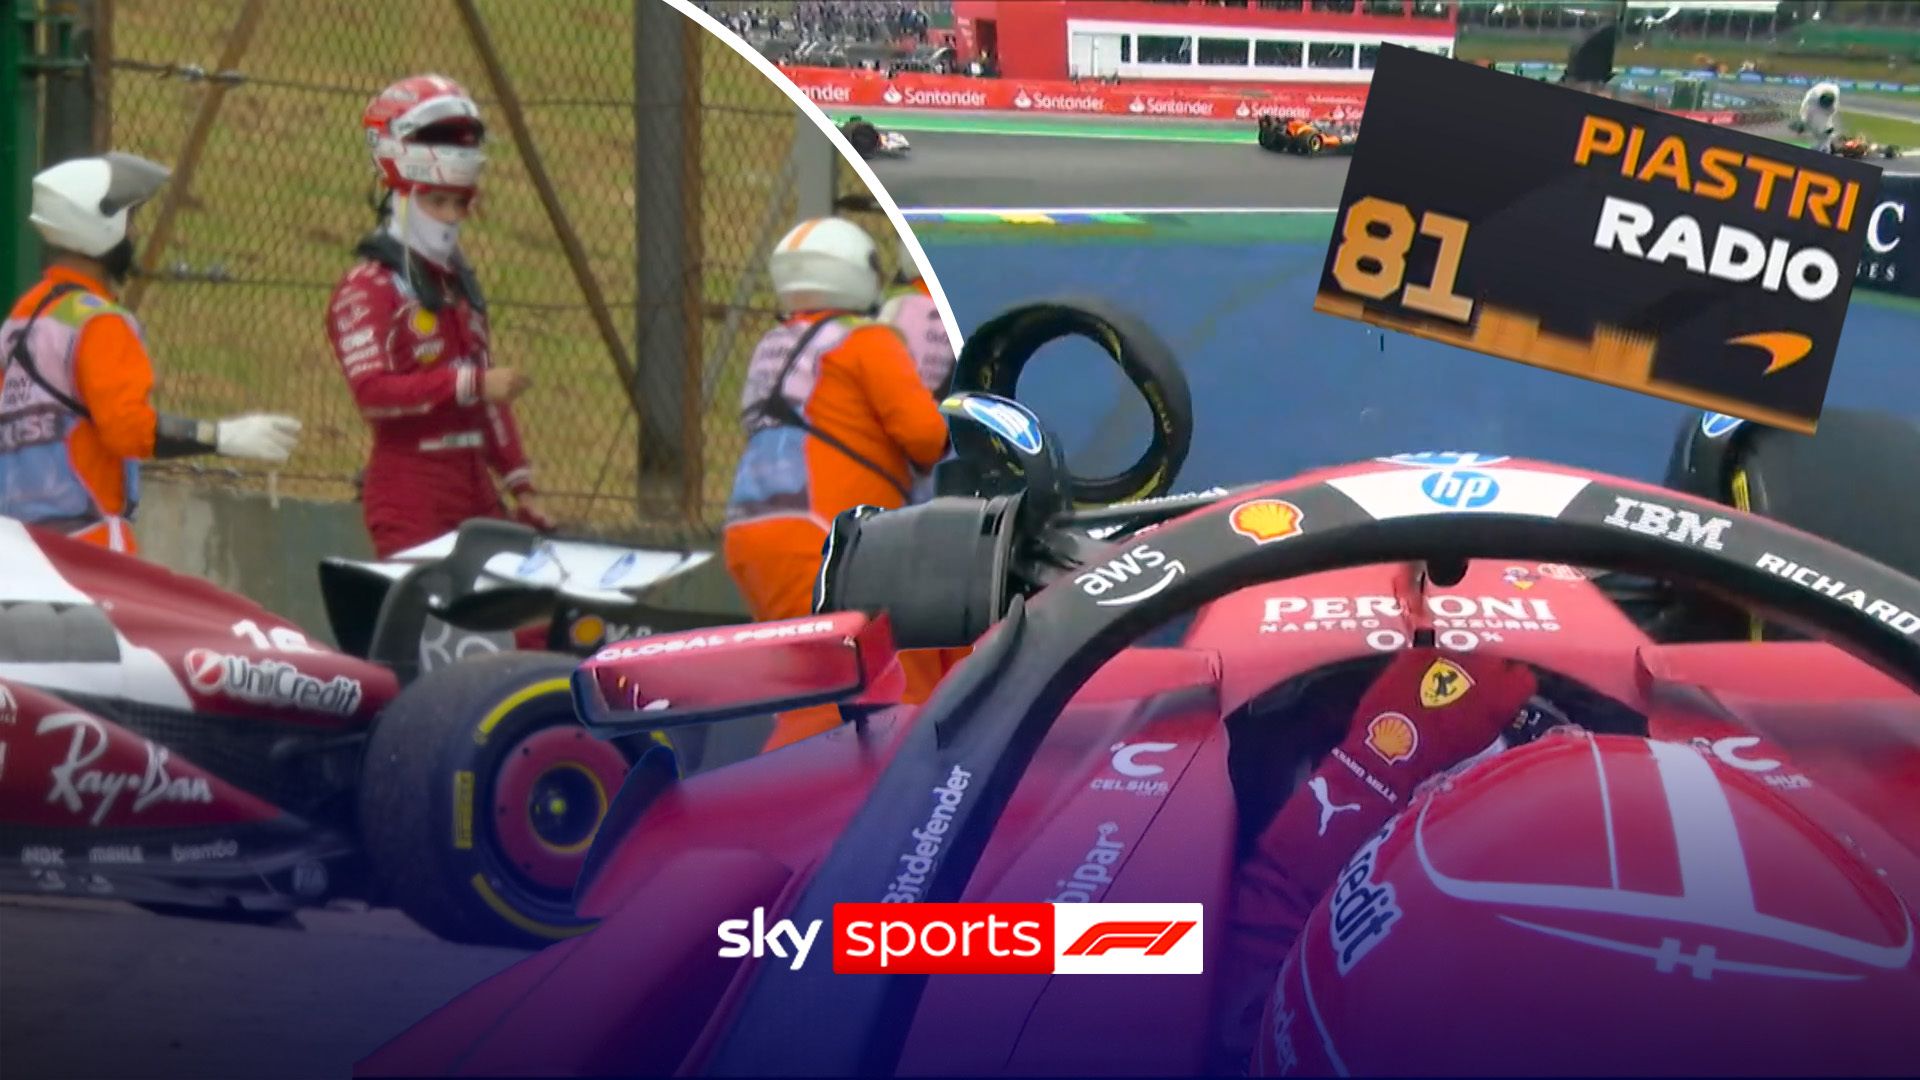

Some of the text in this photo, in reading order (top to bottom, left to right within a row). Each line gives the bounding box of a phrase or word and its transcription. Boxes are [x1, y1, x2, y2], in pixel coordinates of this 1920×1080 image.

[904, 87, 986, 106] Santander
[1032, 91, 1105, 111] Santander
[1147, 98, 1214, 115] Santander
[1430, 468, 1493, 508] hp
[1603, 496, 1733, 550] IBM
[1074, 545, 1166, 596] aws
[1755, 552, 1920, 635] RICHARD
[596, 620, 834, 662] GLOBAL POKER
[1260, 618, 1561, 633] NASTRO AZZURRO
[228, 657, 358, 711] UniCredit
[1090, 777, 1169, 792] CELSIUS
[881, 764, 972, 903] Bitdefender
